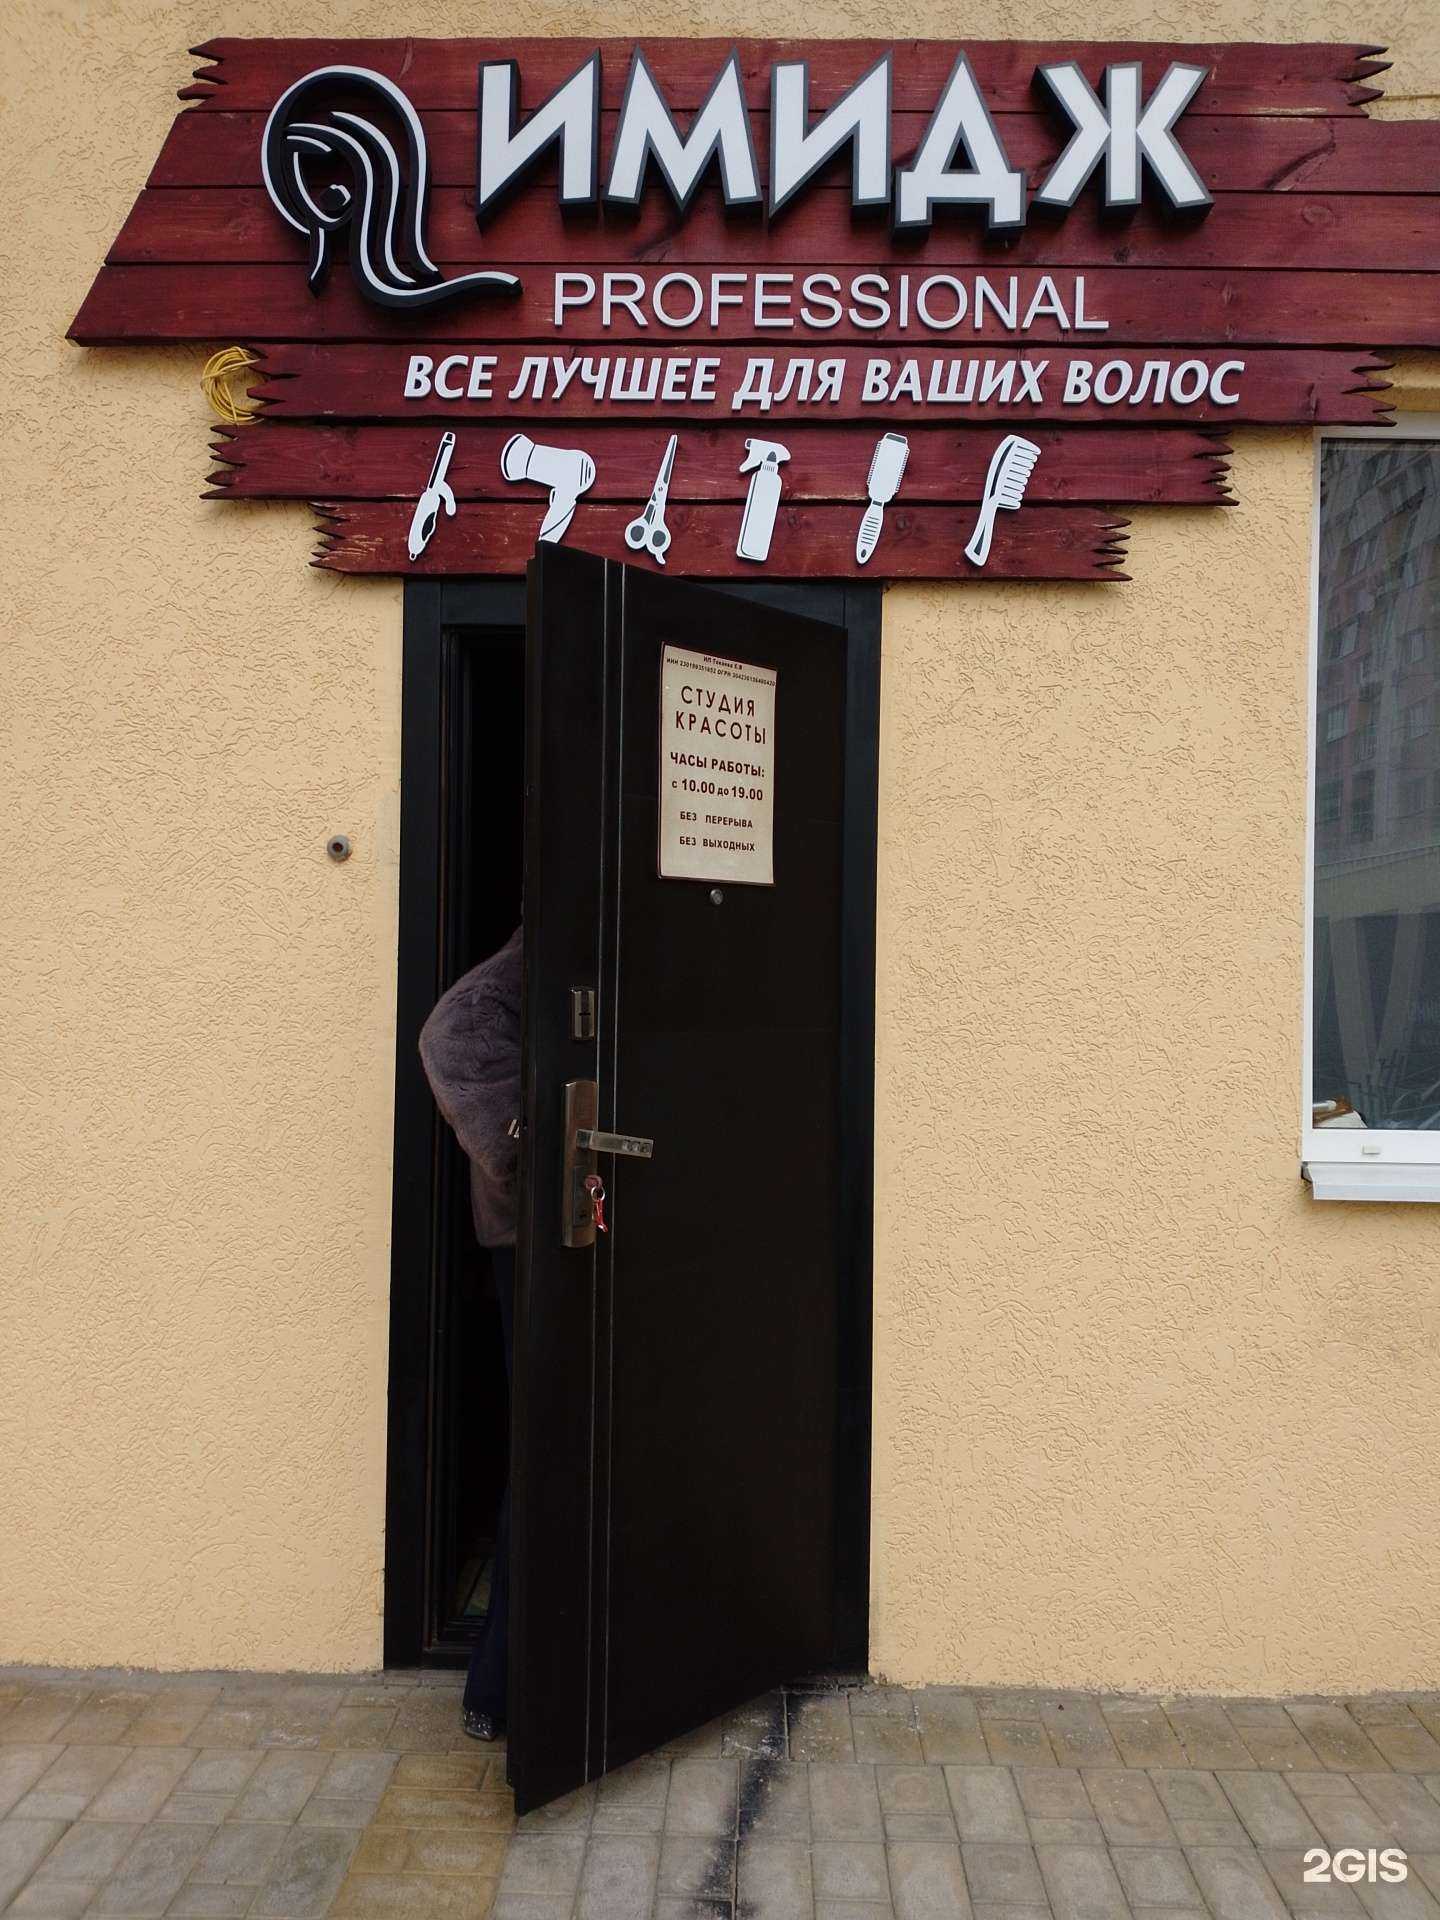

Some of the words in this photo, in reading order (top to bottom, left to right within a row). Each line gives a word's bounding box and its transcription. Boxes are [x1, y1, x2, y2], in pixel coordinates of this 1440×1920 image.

[475, 47, 1214, 232] ИМИДЖ
[553, 272, 1110, 331] PROFESSIONAL
[404, 354, 498, 400] ВСЕ
[506, 355, 721, 402] ЛУЧШЕЕ
[731, 357, 846, 411] ДЛЯ
[859, 358, 1051, 404] ВАШИХ
[1061, 360, 1245, 406] ВОЛОС
[681, 685, 755, 717] СТУДИЯ
[675, 710, 766, 745] КРАСОТЫ
[670, 751, 707, 769] ЧАСЫ
[711, 758, 765, 778] РАБОТЫ:
[682, 778, 715, 794] 10.00
[717, 787, 729, 797] до
[731, 785, 763, 801] 19.00
[680, 811, 697, 821] БЕЗ
[705, 815, 753, 828] ПЕРЕРЫВА
[679, 836, 697, 846] БЕЗ
[702, 838, 755, 852] ВЫХОДНЫХ
